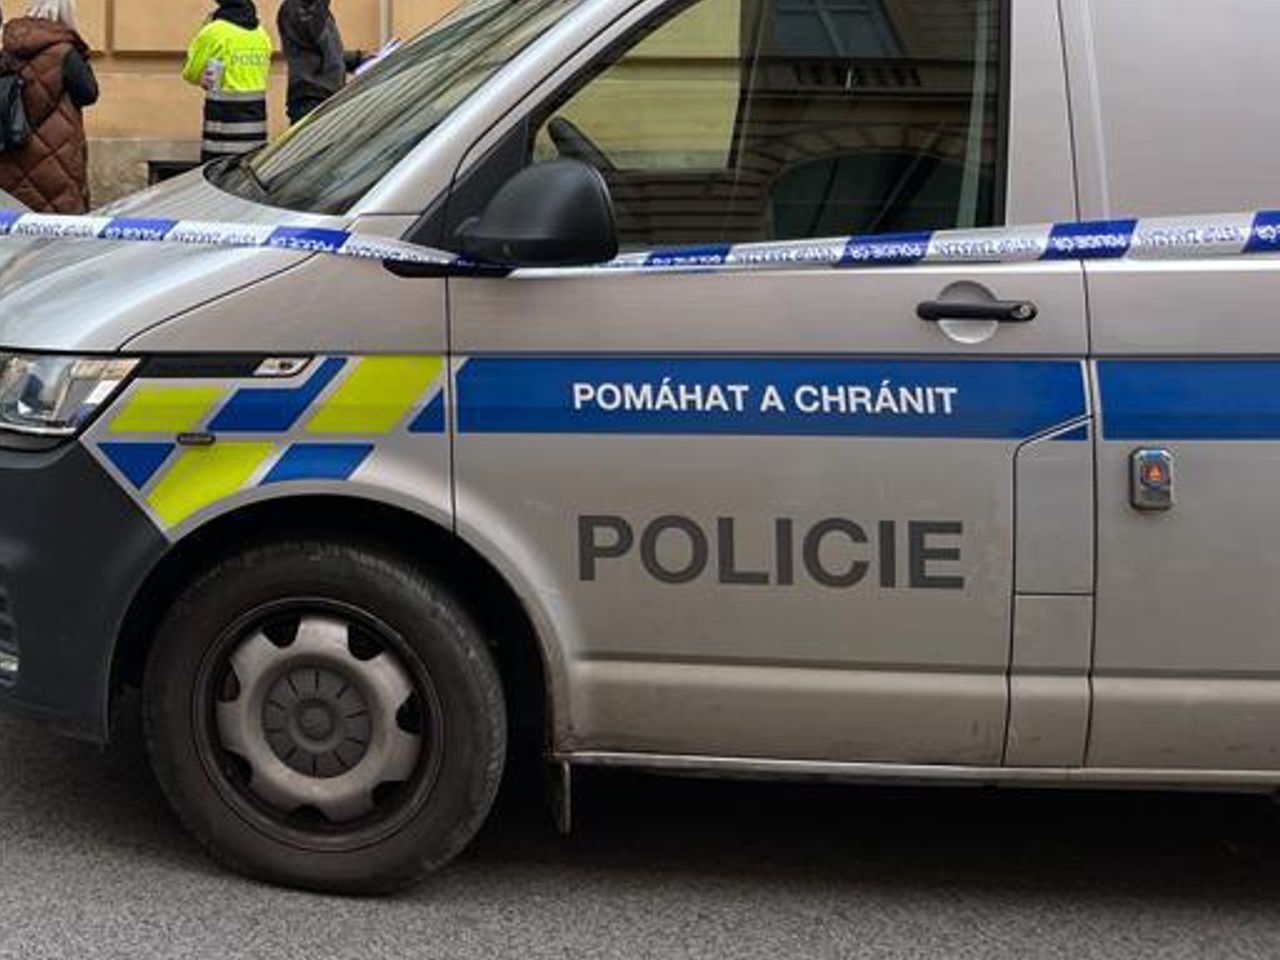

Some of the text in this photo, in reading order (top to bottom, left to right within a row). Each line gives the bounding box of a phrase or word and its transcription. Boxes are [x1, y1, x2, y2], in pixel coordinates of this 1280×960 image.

[574, 378, 957, 413] POMÁHAT A CHRÁNIT
[578, 515, 965, 590] POLICIE
